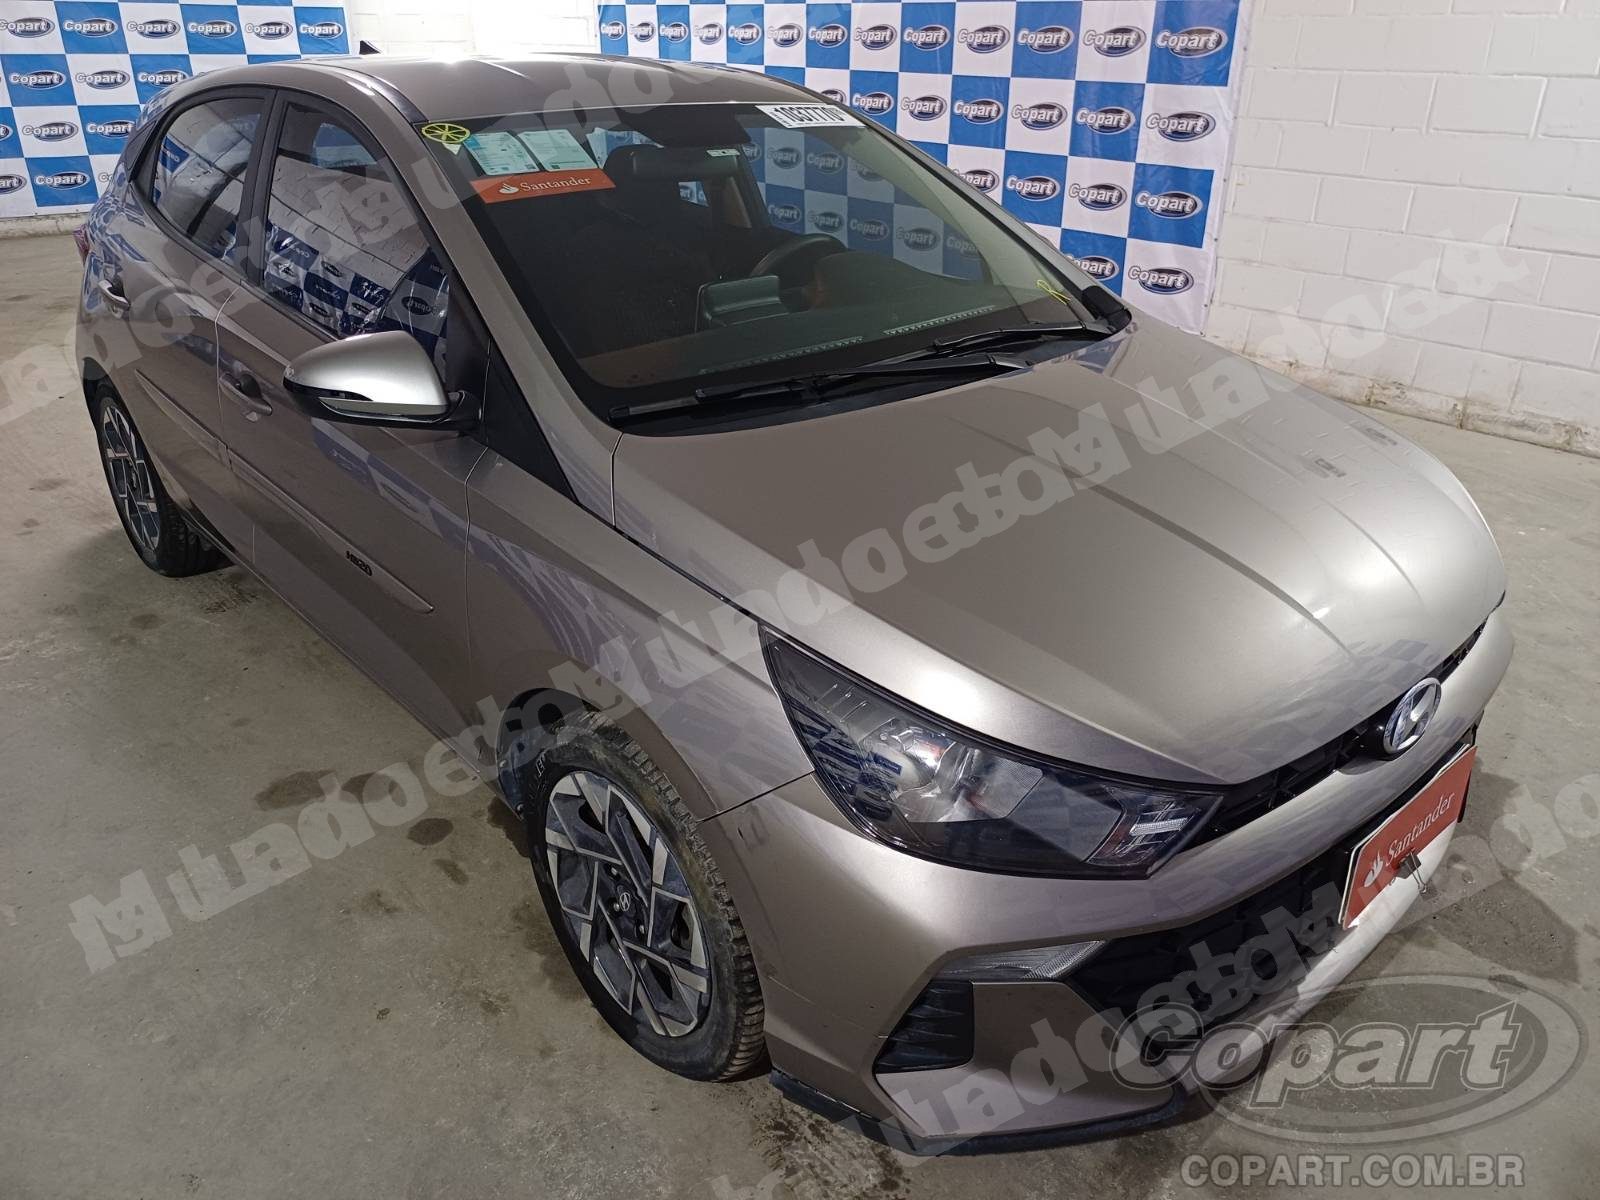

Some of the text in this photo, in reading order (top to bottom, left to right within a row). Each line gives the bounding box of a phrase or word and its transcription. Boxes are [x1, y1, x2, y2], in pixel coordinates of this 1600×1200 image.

[64, 20, 112, 32] Copart
[128, 22, 172, 33] Copart
[188, 22, 232, 34] Copart
[246, 23, 286, 35] Copart
[300, 23, 339, 35] Copart
[729, 26, 757, 41] Copart
[768, 26, 798, 41] Copart
[808, 26, 842, 42] Copart
[854, 27, 890, 43] Copart
[904, 27, 945, 44] Copart
[958, 29, 1002, 47] Copart
[1018, 28, 1067, 47] Copart
[1084, 30, 1136, 49] Copart
[1156, 30, 1218, 52] Copart
[10, 73, 60, 86] Copart
[75, 73, 124, 86] Copart
[853, 94, 889, 109] Copart
[901, 97, 941, 114] Copart
[954, 101, 998, 118] Copart
[1012, 105, 1060, 124] Copart
[1076, 108, 1131, 129] Copart
[1147, 113, 1207, 133] Copart
[22, 124, 71, 136] Copart
[807, 153, 840, 169] Copart
[35, 175, 84, 188] Copart
[520, 177, 591, 193] Santander
[1007, 175, 1054, 196] Copart
[1069, 183, 1121, 204] Copart
[1136, 191, 1194, 213] Copart
[768, 204, 798, 222] Copart
[850, 218, 887, 237] Copart
[1129, 266, 1186, 289] Copart
[1385, 792, 1455, 867] Santander
